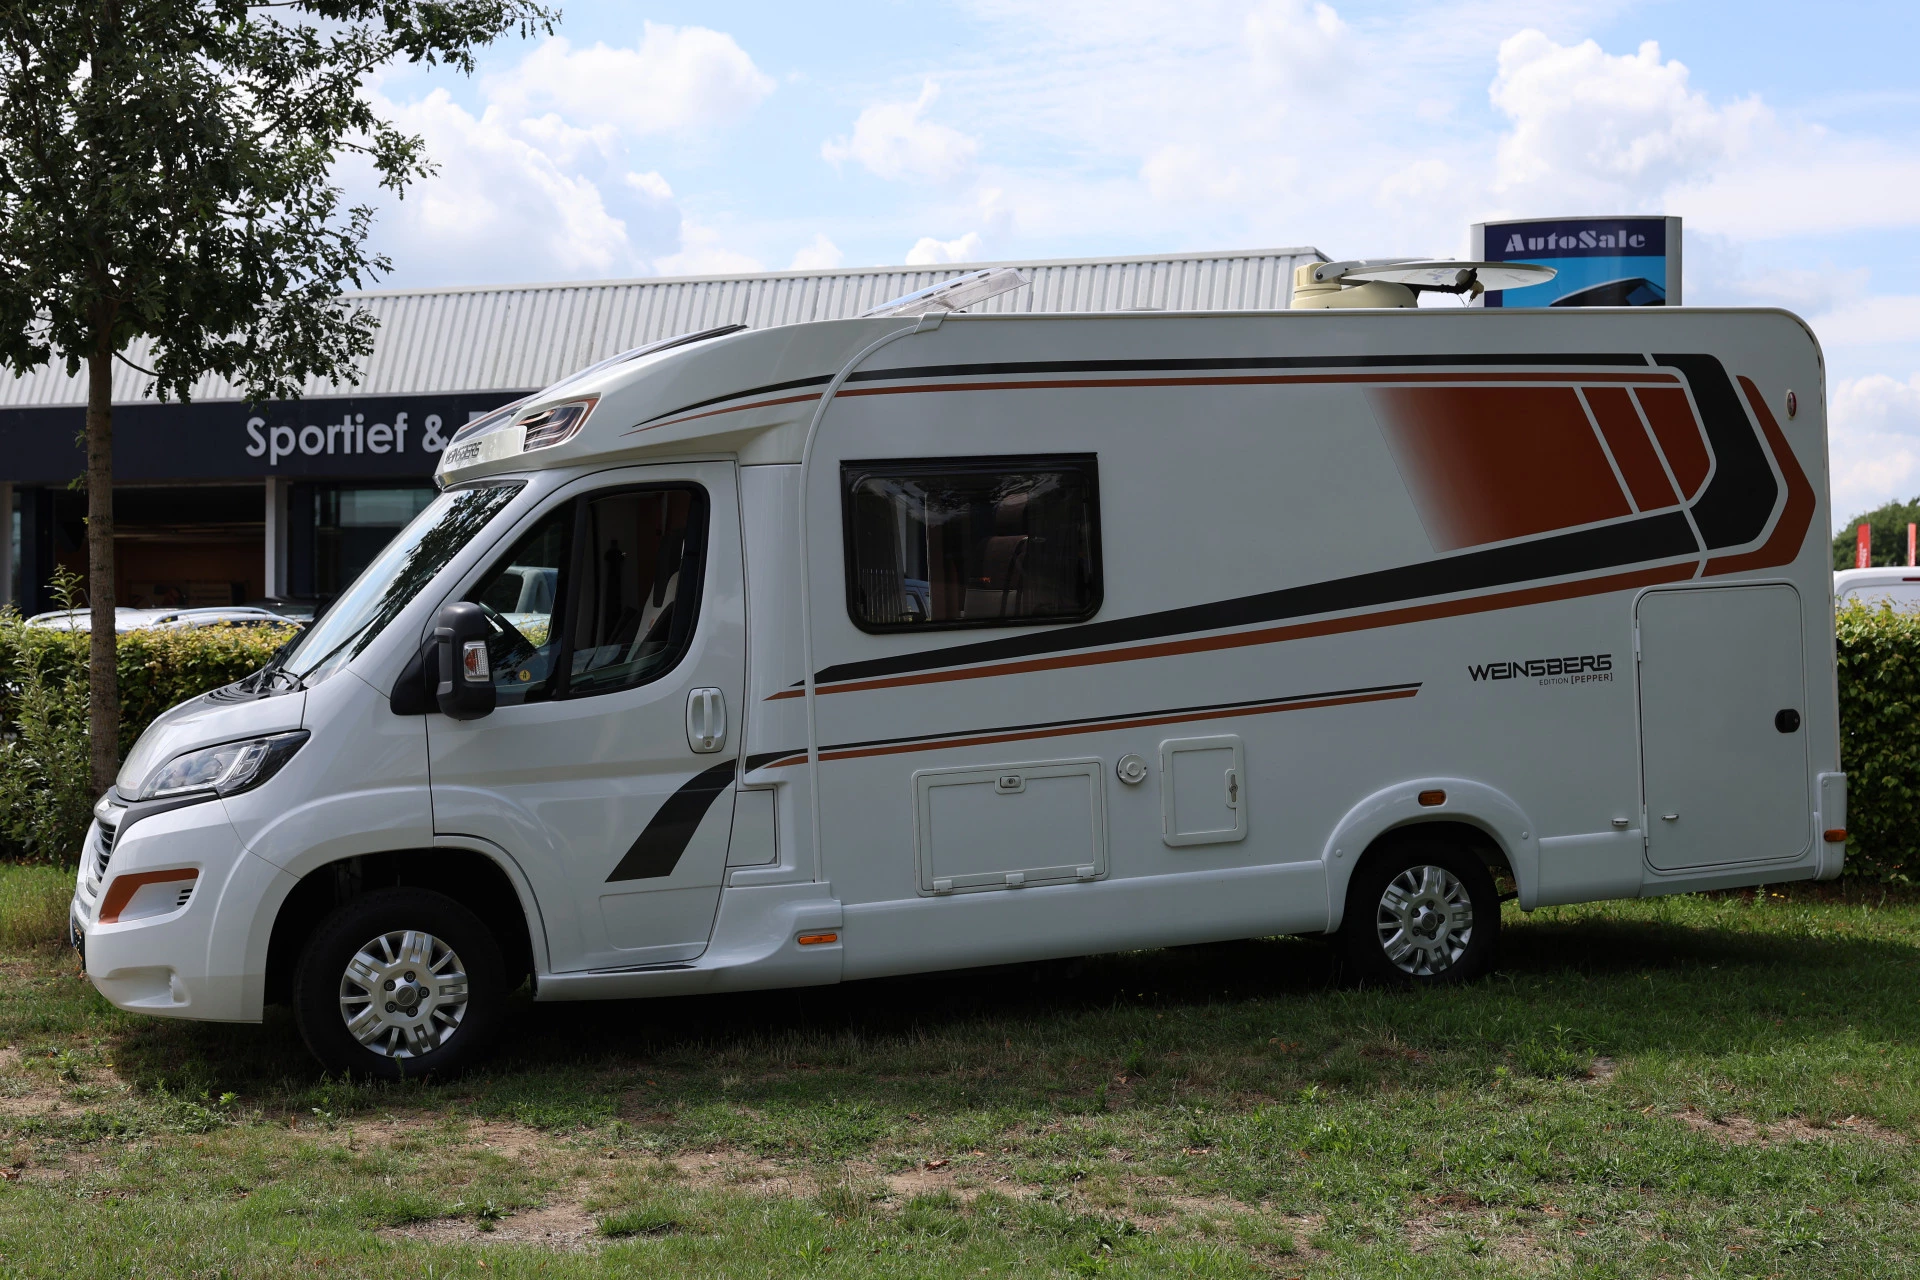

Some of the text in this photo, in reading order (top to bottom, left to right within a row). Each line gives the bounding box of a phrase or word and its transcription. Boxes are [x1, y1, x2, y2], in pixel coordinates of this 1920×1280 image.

[1505, 230, 1645, 252] AutoSale
[246, 412, 448, 465] Sportief &
[1468, 654, 1612, 682] WEINSBERG
[1539, 673, 1613, 686] EDITION [PEPPER]
